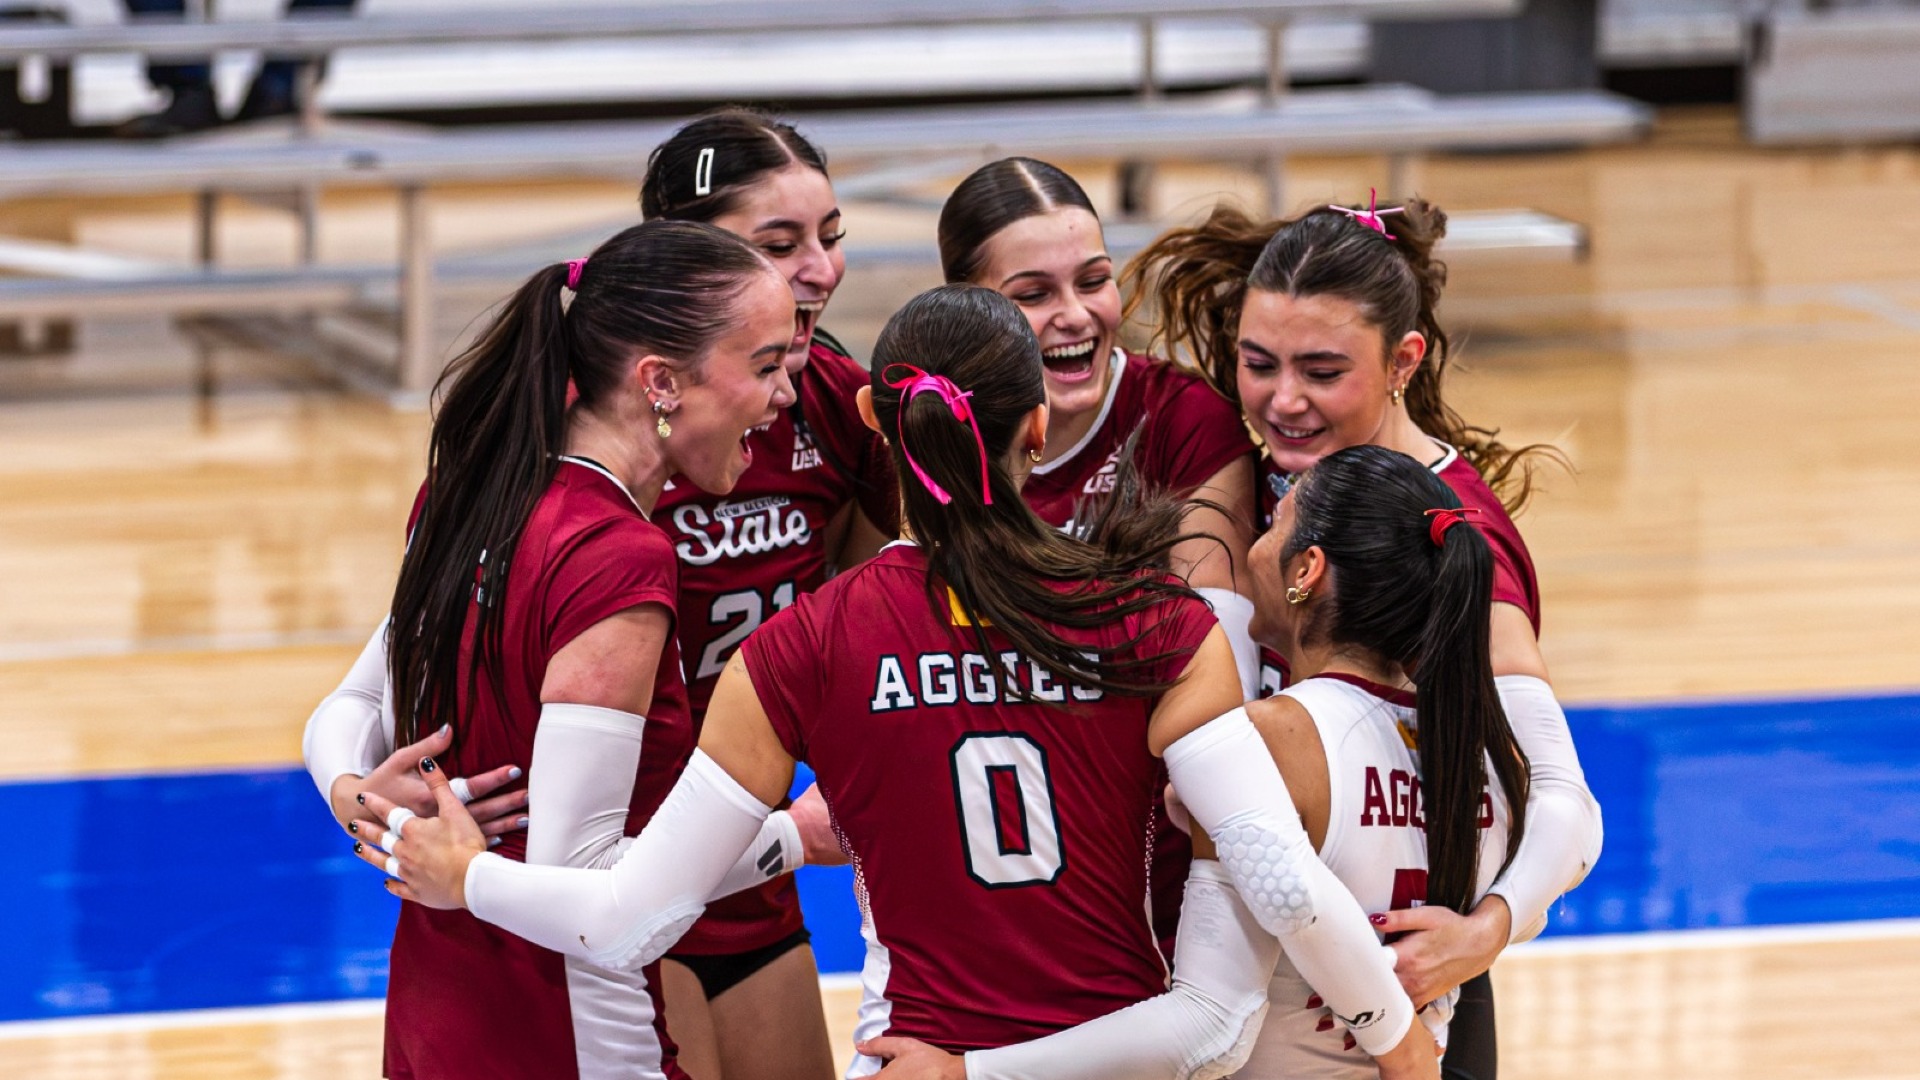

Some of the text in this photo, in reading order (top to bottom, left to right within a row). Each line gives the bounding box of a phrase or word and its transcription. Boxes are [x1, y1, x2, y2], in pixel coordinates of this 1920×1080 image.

[791, 447, 823, 471] USA
[1082, 473, 1118, 494] US
[715, 504, 740, 518] NEW
[673, 499, 812, 566] State
[949, 730, 1068, 890] 0
